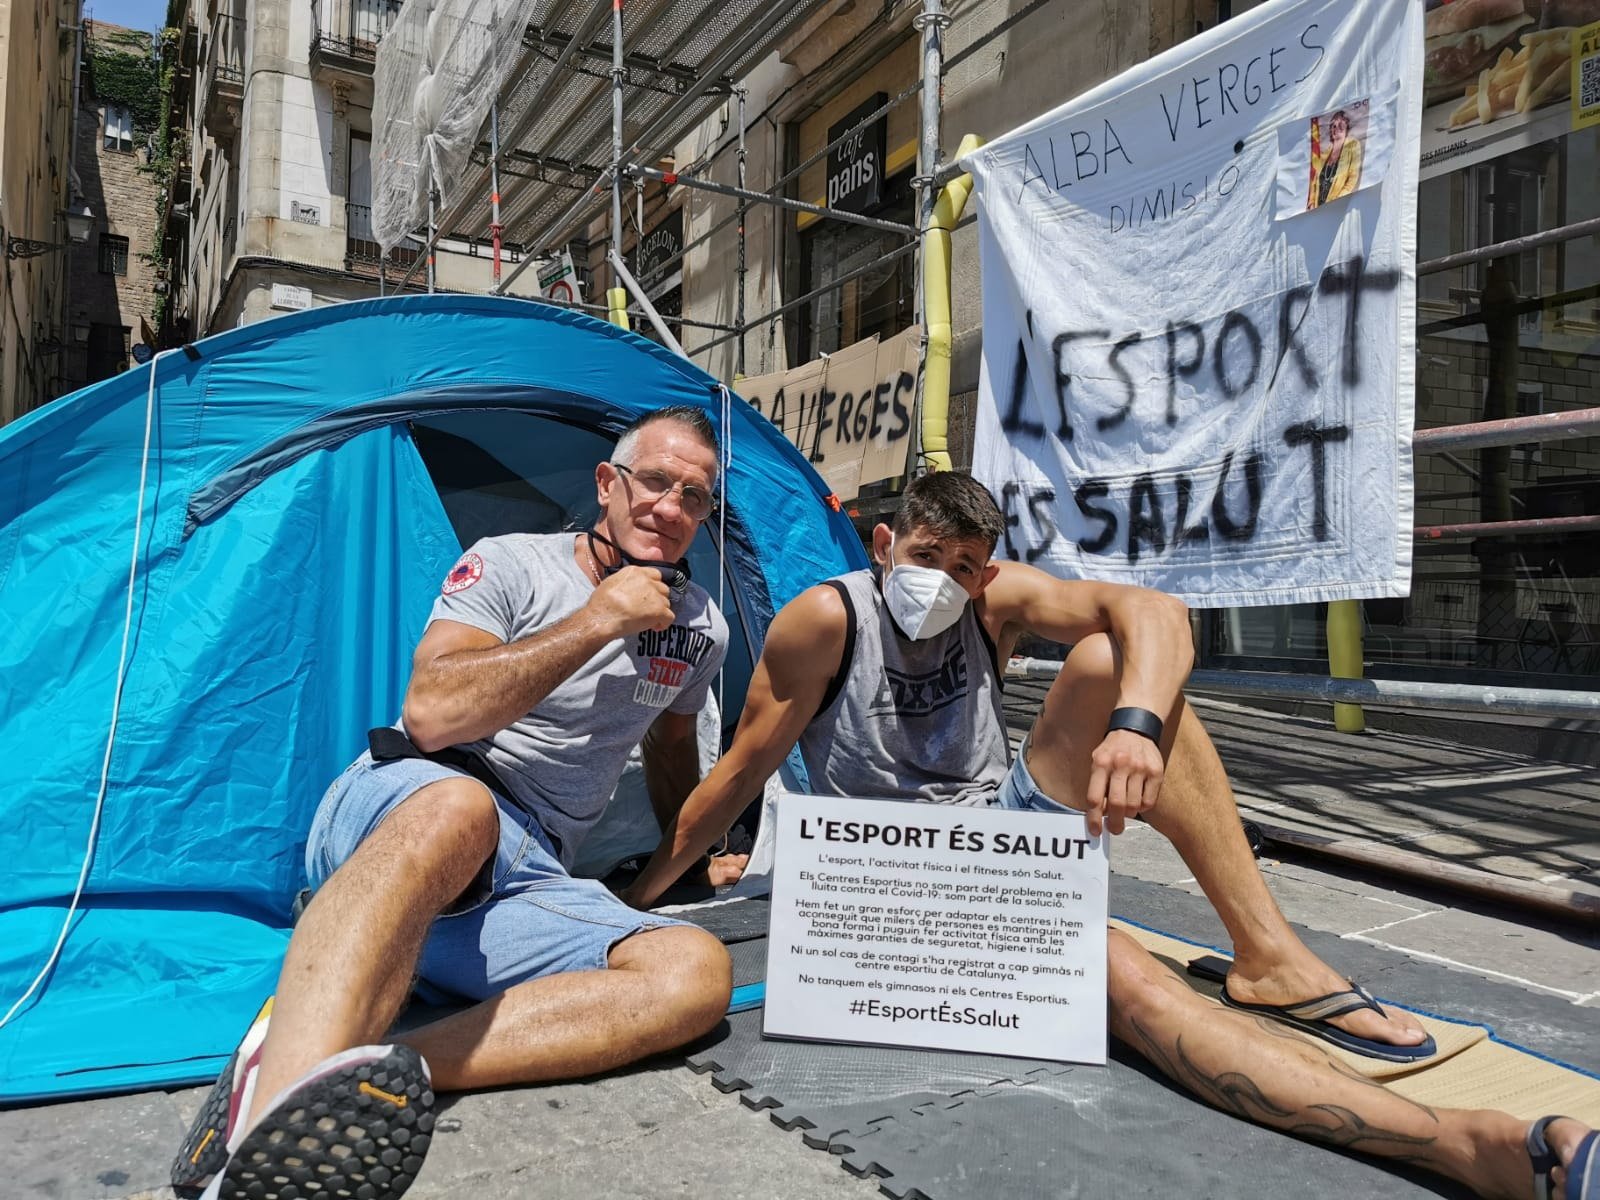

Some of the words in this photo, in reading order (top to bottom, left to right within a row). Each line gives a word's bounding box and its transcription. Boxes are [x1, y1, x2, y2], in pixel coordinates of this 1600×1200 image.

[1018, 120, 1133, 204] ALBA
[1160, 24, 1325, 142] VERGES
[828, 152, 874, 209] pans
[795, 371, 914, 463] VERGES
[1074, 420, 1350, 566] SALUT
[637, 624, 715, 667] SUPERDRY
[647, 657, 689, 687] STATE
[800, 817, 940, 849] L'ESPORT
[949, 824, 984, 852] ÉS
[992, 833, 1090, 860] SALUT
[818, 854, 865, 867] L'esport,
[869, 858, 919, 870] l'activitat
[923, 862, 951, 872] física
[954, 864, 958, 873] i
[961, 865, 970, 874] el
[974, 865, 1009, 876] fitness
[1012, 869, 1031, 877] són
[1034, 870, 1064, 880] Salut.
[800, 871, 815, 881] Els
[818, 873, 860, 884] Centres
[863, 876, 912, 889] Esportius
[915, 880, 928, 889] no
[932, 882, 953, 891] som
[956, 884, 978, 894] part
[982, 885, 998, 894] del
[1002, 888, 1052, 899] problema
[1056, 891, 1069, 899] en
[1072, 891, 1082, 900] la
[812, 881, 837, 891] lluita
[840, 885, 875, 895] contra
[879, 886, 888, 896] el
[891, 887, 941, 899] Covid-19:
[945, 893, 966, 901] som
[969, 895, 992, 904] part
[995, 895, 1009, 904] de
[1012, 896, 1022, 905] la
[1025, 898, 1065, 908] solució.
[795, 899, 820, 909] Hem
[824, 901, 839, 910] fet
[859, 905, 883, 914] gran
[887, 905, 921, 917] esforç
[924, 910, 942, 920] per
[946, 911, 989, 923] adaptar
[993, 913, 1007, 923] els
[1010, 916, 1051, 926] centres
[1054, 918, 1057, 926] i
[1060, 918, 1083, 928] hem
[798, 909, 857, 922] aconseguit
[861, 915, 881, 925] que
[884, 915, 915, 926] milers
[918, 916, 932, 926] de
[935, 919, 984, 931] persones
[987, 924, 999, 932] es
[1002, 925, 1062, 937] mantinguin
[1065, 930, 1079, 938] en
[807, 928, 853, 940] màximes
[857, 932, 908, 944] garanties
[911, 935, 925, 945] de
[928, 937, 983, 950] seguretat,
[987, 942, 1027, 953] higiene
[1030, 944, 1033, 953] i
[1036, 945, 1065, 956] salut.
[812, 919, 839, 929] bona
[843, 921, 874, 932] forma
[877, 923, 880, 932] i
[883, 925, 920, 936] puguin
[924, 927, 939, 935] fer
[942, 929, 987, 940] activitat
[991, 931, 1020, 942] física
[1023, 933, 1046, 944] amb
[1050, 936, 1065, 946] les
[790, 945, 803, 954] Ni
[806, 948, 819, 956] un
[822, 948, 837, 957] sol
[840, 951, 858, 959] cas
[862, 950, 875, 960] de
[879, 952, 919, 965] contagi
[922, 955, 945, 965] s'ha
[948, 957, 994, 969] registrat
[998, 962, 1005, 970] a
[1008, 963, 1029, 973] cap
[1074, 967, 1085, 977] ni
[855, 960, 890, 970] centre
[893, 963, 937, 974] esportiu
[941, 966, 954, 976] de
[958, 966, 1017, 982] Catalunya.
[798, 974, 815, 984] No
[817, 977, 864, 988] tanquem
[868, 979, 883, 989] els
[886, 981, 935, 993] gimnasos
[939, 985, 949, 994] ni
[952, 986, 966, 996] els
[970, 987, 1013, 1000] Centres
[1016, 991, 1070, 1005] Esportius.
[849, 1000, 1020, 1029] #EsportÉsSalut
